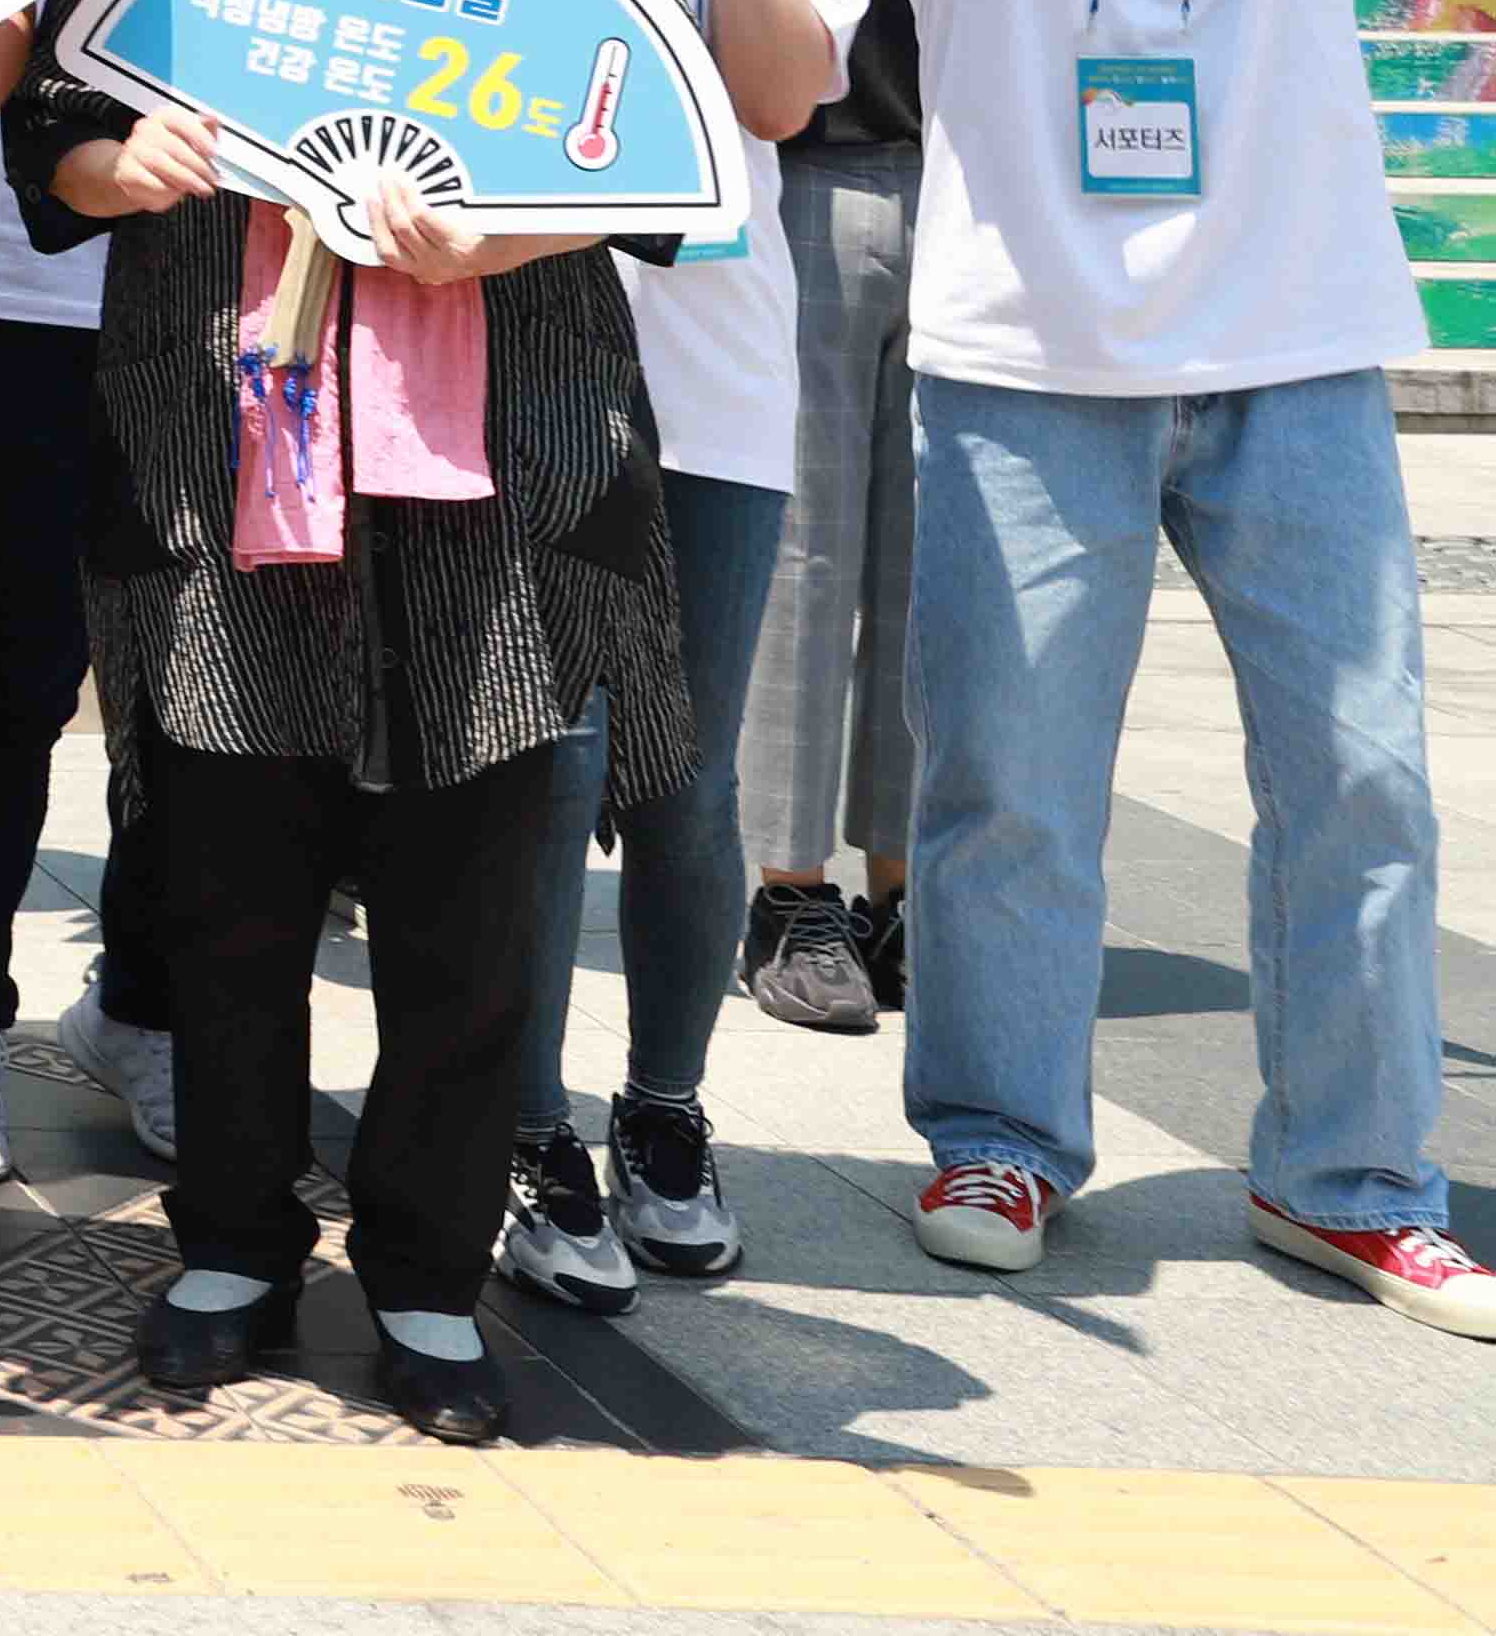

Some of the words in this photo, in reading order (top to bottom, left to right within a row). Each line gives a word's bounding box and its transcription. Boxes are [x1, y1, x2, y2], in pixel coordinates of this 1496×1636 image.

[333, 14, 406, 62] 온도
[246, 36, 317, 84] 건강
[324, 56, 397, 104] 온도
[1096, 128, 1186, 151] 서포터즈
